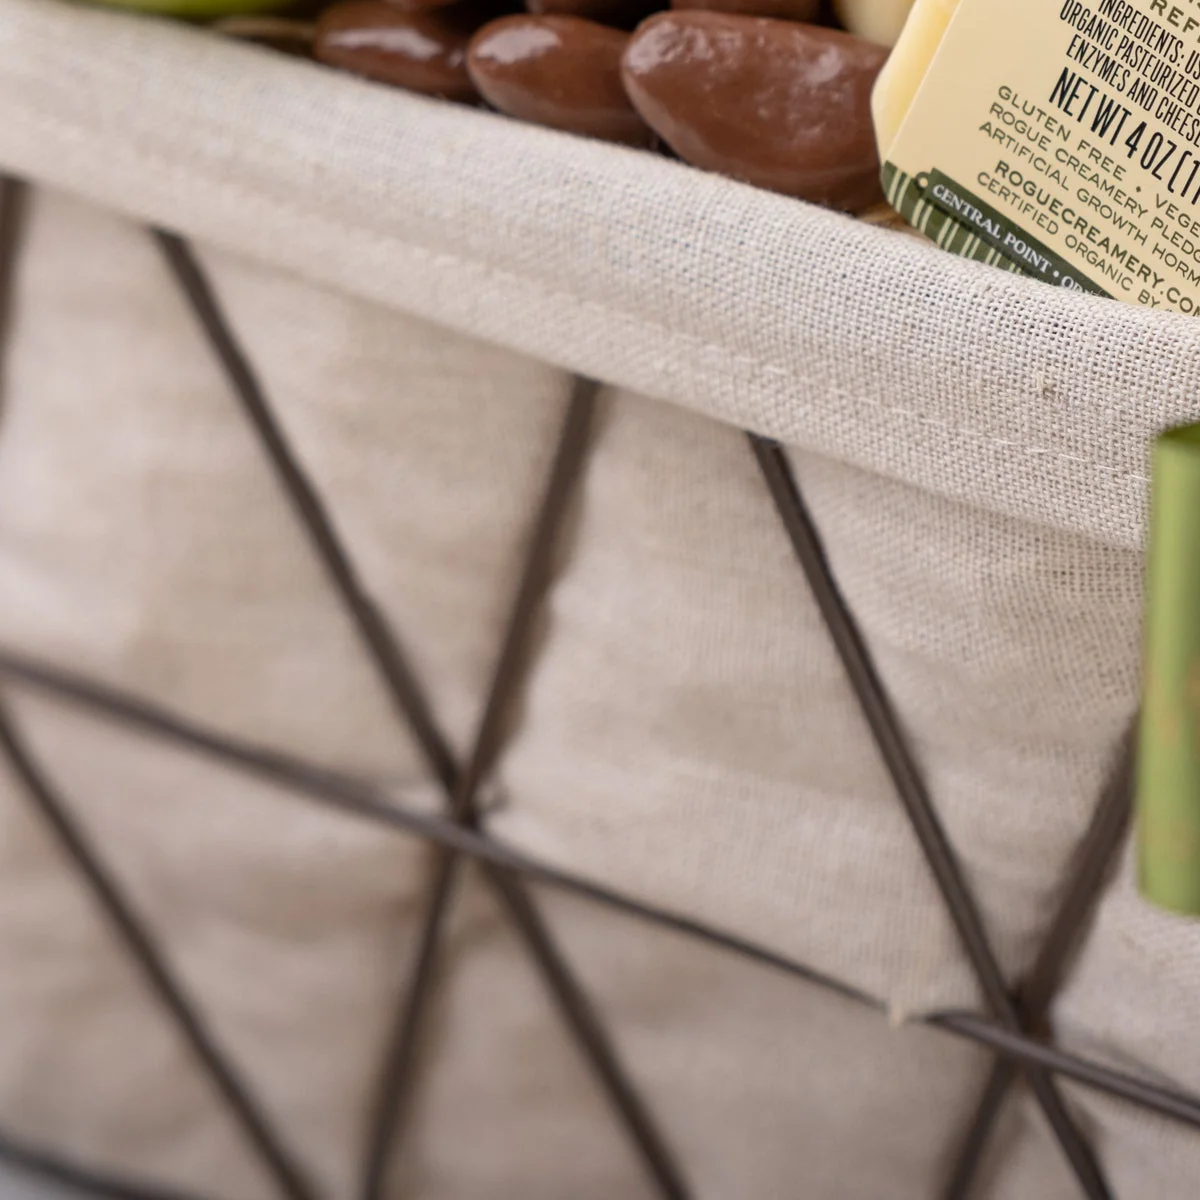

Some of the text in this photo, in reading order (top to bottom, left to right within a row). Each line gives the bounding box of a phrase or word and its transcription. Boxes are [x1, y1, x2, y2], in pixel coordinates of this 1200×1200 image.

[1049, 67, 1099, 123] NET
[1090, 94, 1132, 147] WT
[1125, 121, 1147, 159] 4
[1140, 132, 1178, 180] OZ
[1066, 33, 1130, 93] ENZYMES
[1127, 83, 1159, 113] AND
[1117, 34, 1200, 108] PASTEURIZED
[979, 121, 1069, 191] ARTIFICIAL
[1076, 187, 1149, 247] GROWTH
[988, 103, 1048, 153] ROGUE
[1054, 148, 1149, 218] CREAMERY
[997, 84, 1071, 142] GLUTEN
[1077, 140, 1127, 183] FREE
[932, 184, 1053, 273] CENTRAL POINT
[976, 171, 1059, 236] CERTIFIED
[1064, 234, 1134, 291] ORGANIC
[1137, 288, 1161, 309] BY
